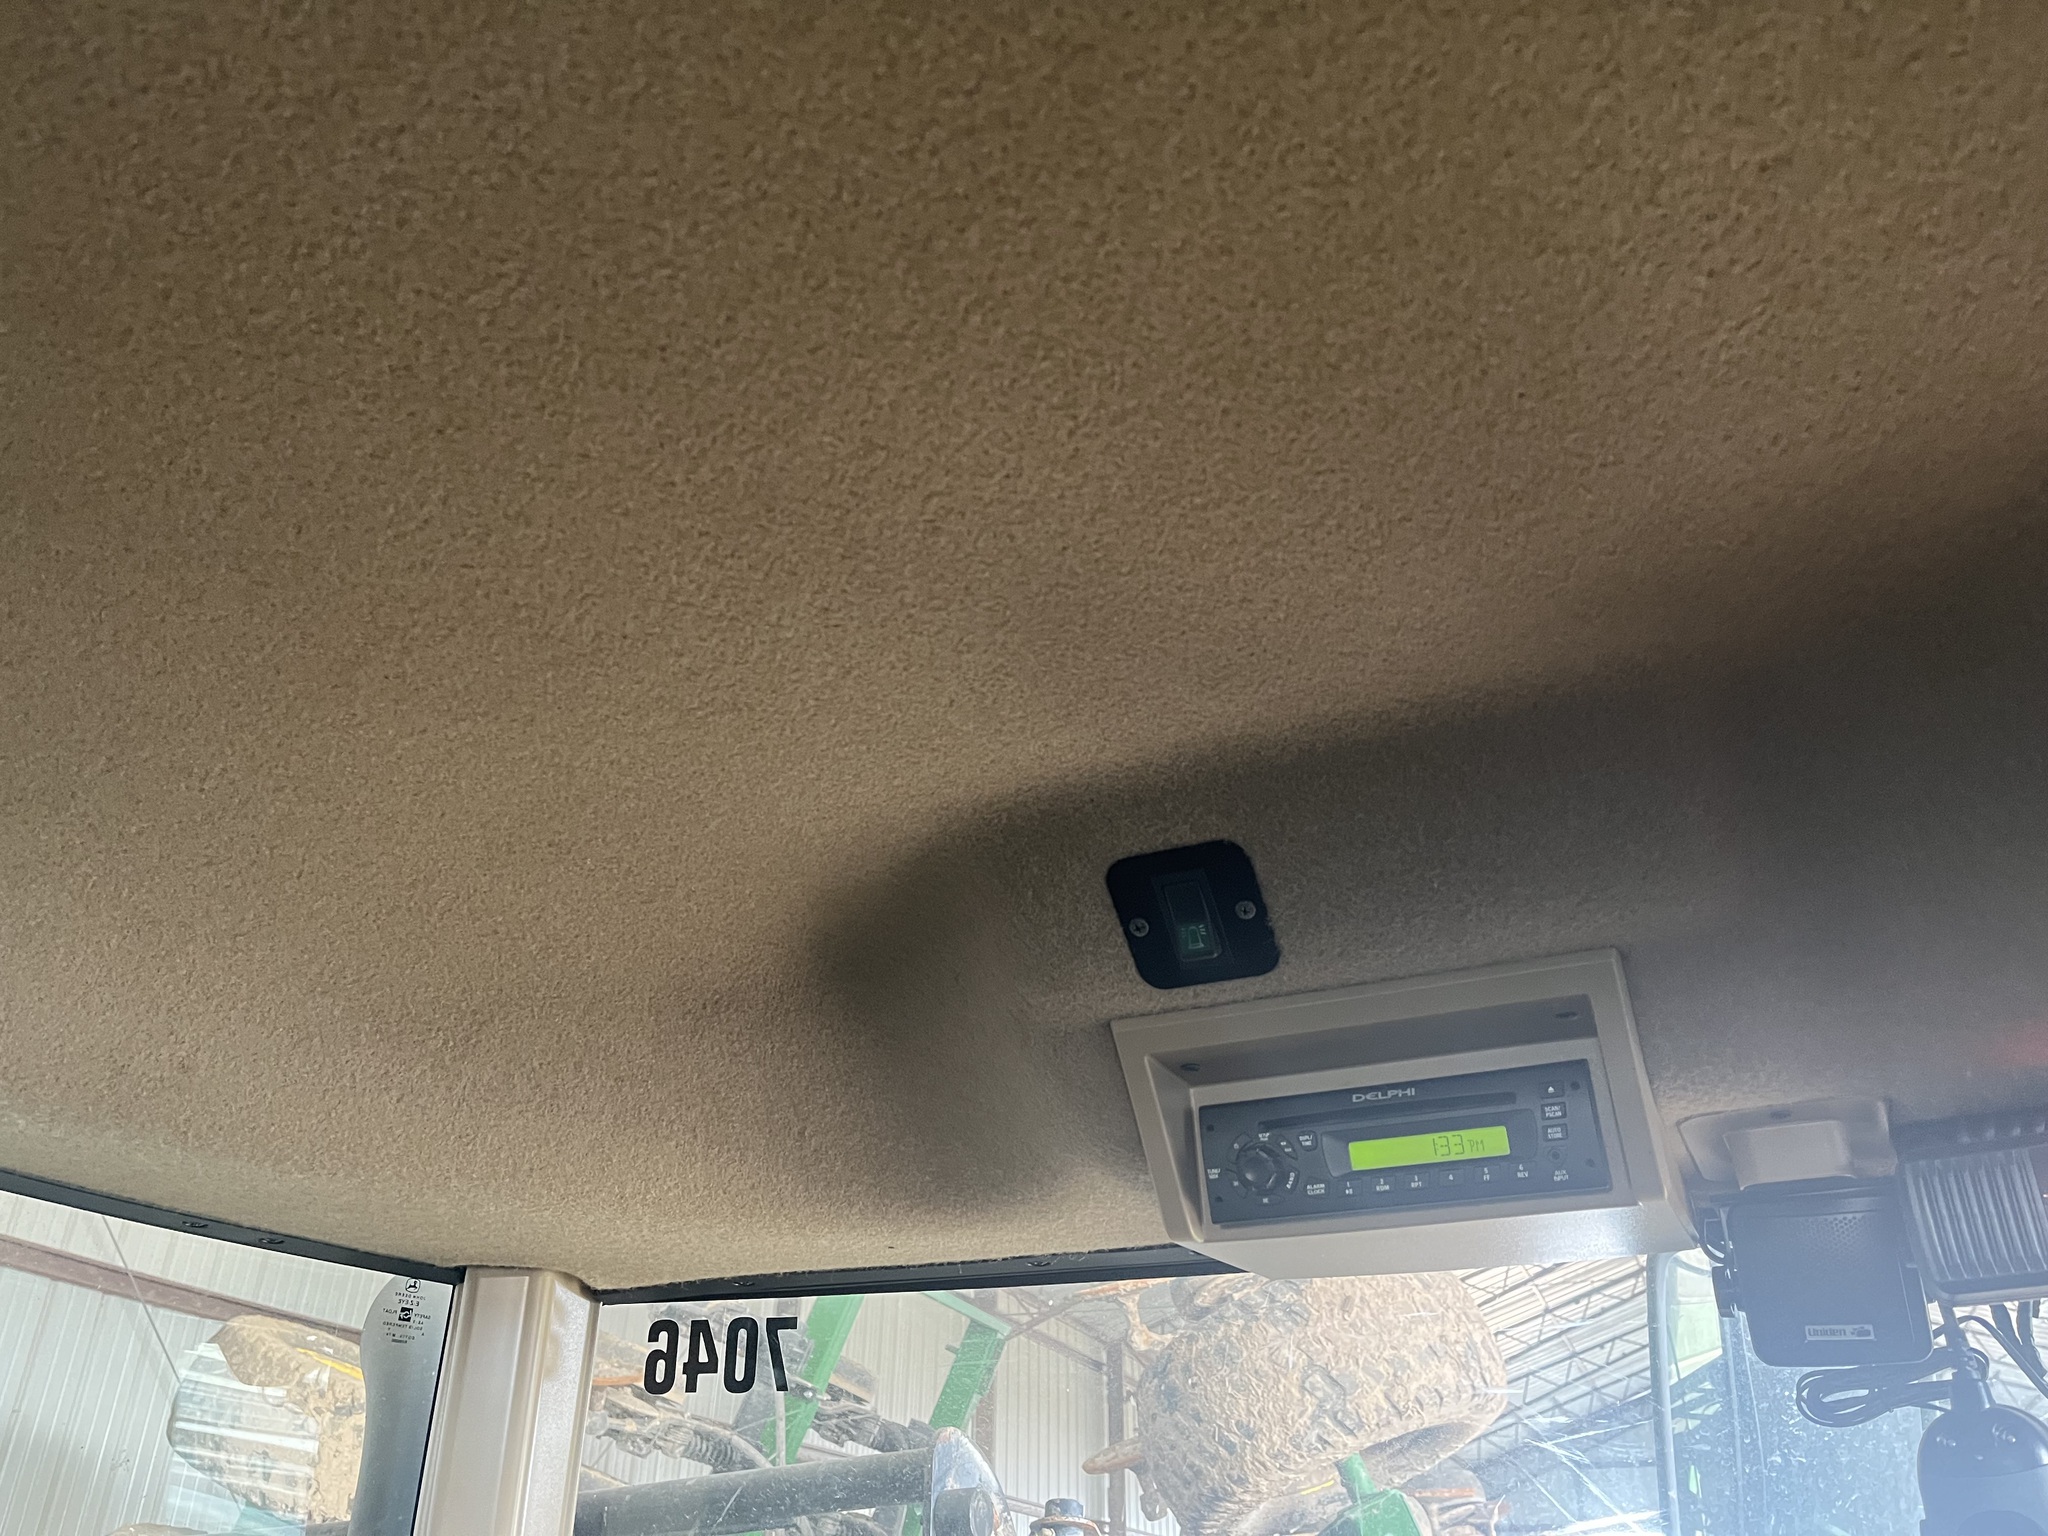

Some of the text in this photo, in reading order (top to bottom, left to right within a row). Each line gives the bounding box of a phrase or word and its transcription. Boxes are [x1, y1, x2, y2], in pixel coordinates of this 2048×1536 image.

[1352, 1088, 1415, 1102] DELPHI
[1466, 1139, 1485, 1153] PM
[1375, 1184, 1390, 1192] RDM
[1808, 1328, 1847, 1336] Uniden
